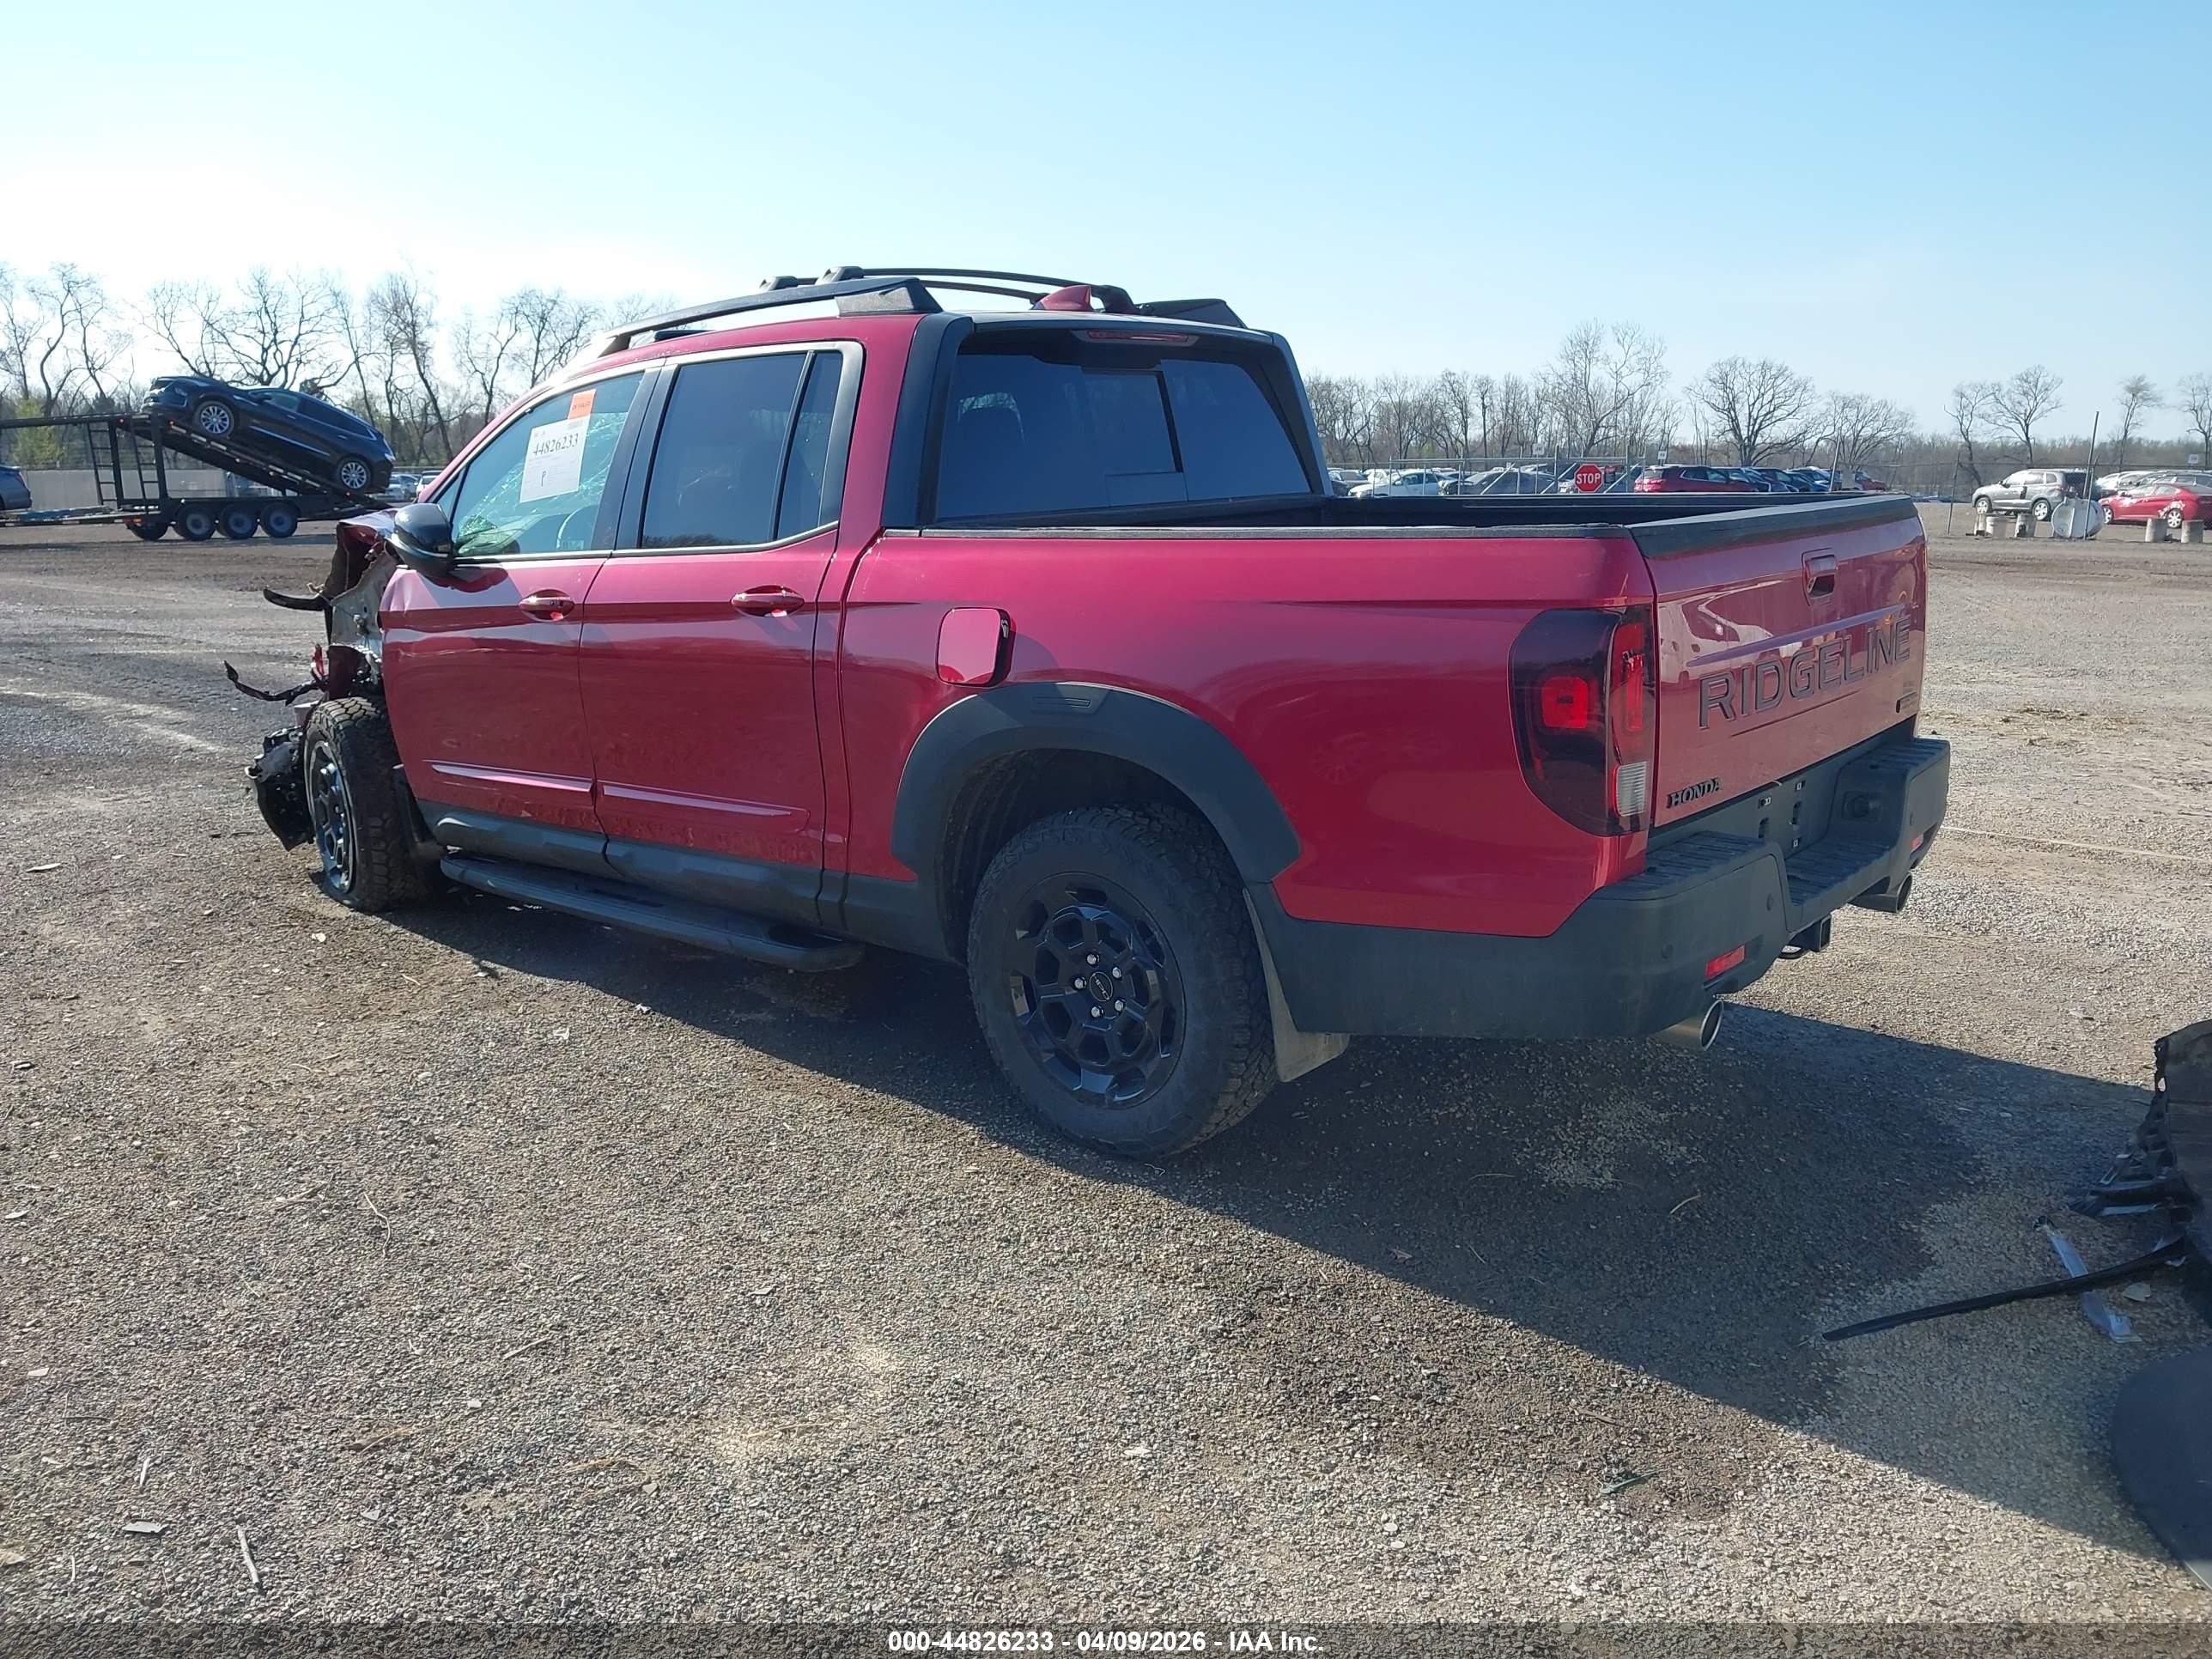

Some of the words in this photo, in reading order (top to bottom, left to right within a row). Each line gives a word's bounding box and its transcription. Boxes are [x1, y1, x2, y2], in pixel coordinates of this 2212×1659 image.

[532, 433, 579, 456] 44826233
[1576, 472, 1601, 484] STOP
[1698, 615, 1911, 730] RIDGELINE
[1666, 777, 1723, 808] HONDA
